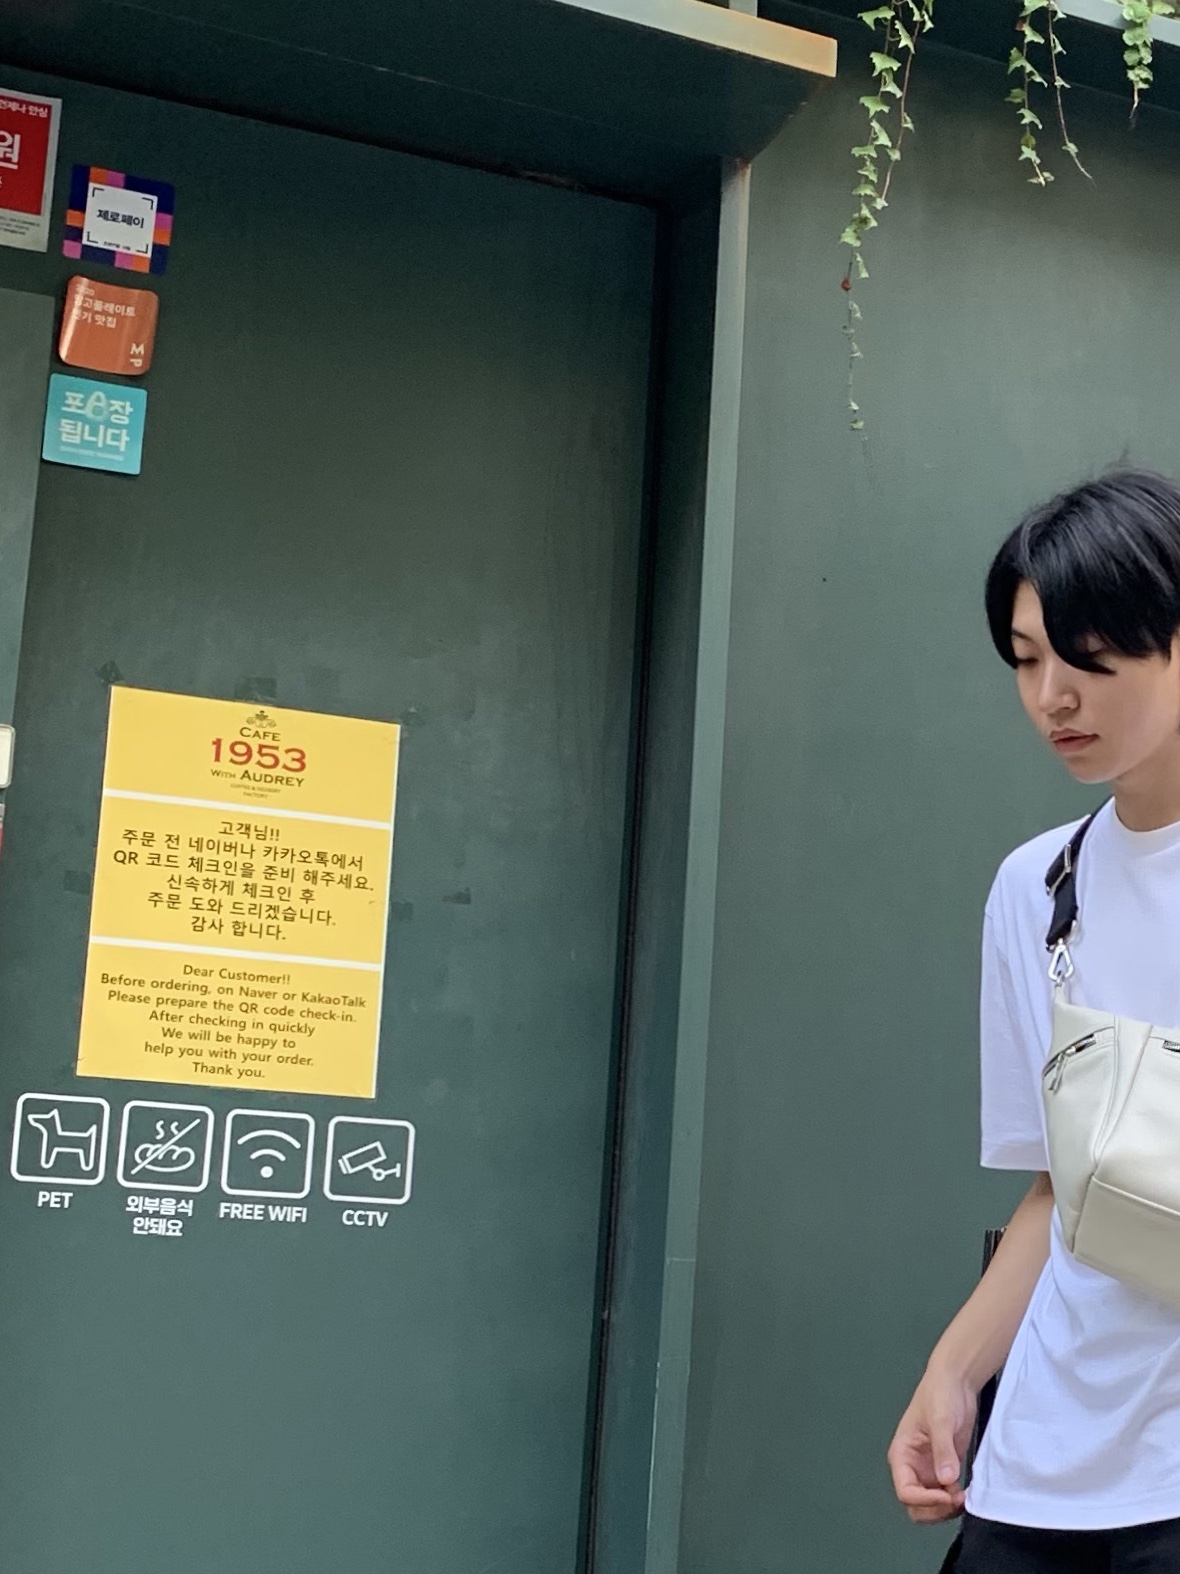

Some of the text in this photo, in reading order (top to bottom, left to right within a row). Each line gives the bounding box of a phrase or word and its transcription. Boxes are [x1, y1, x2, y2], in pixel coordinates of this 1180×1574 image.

[97, 209, 144, 229] 제로페이
[94, 314, 117, 329] 맛집
[59, 418, 130, 452] 됩니다
[239, 726, 281, 742] CAFE
[211, 737, 306, 773] 1953
[240, 769, 304, 788] AUDREY
[219, 821, 280, 841] 고객님!!
[122, 828, 364, 872] 주문 전 네이버나 카카오톡에서
[113, 849, 375, 892] QR 코드 체크인을 준비 해주세요.
[167, 873, 315, 904] 신속하게 체크인 후
[147, 891, 336, 926] 주문 도와 드리겠습니다.
[191, 916, 286, 941] 감사 합니다.
[183, 964, 291, 985] Dear Customer!!
[101, 973, 145, 988] Before
[217, 985, 233, 996] on
[239, 987, 277, 1001] Naver
[282, 991, 296, 1001] or
[301, 992, 367, 1009] KakaoTalk
[108, 990, 357, 1023] Please prepare the QR code check-in.
[149, 1010, 315, 1037] After checking in quickly
[161, 1027, 296, 1049] We will be happy to
[144, 1041, 315, 1067] help you with your order.
[192, 1062, 266, 1080] Thank you.
[37, 1190, 73, 1209] PET
[125, 1195, 194, 1217] 외부음식
[219, 1202, 308, 1224] FREE WIFI
[341, 1209, 389, 1228] CCTV
[132, 1216, 183, 1237] 안돼요
